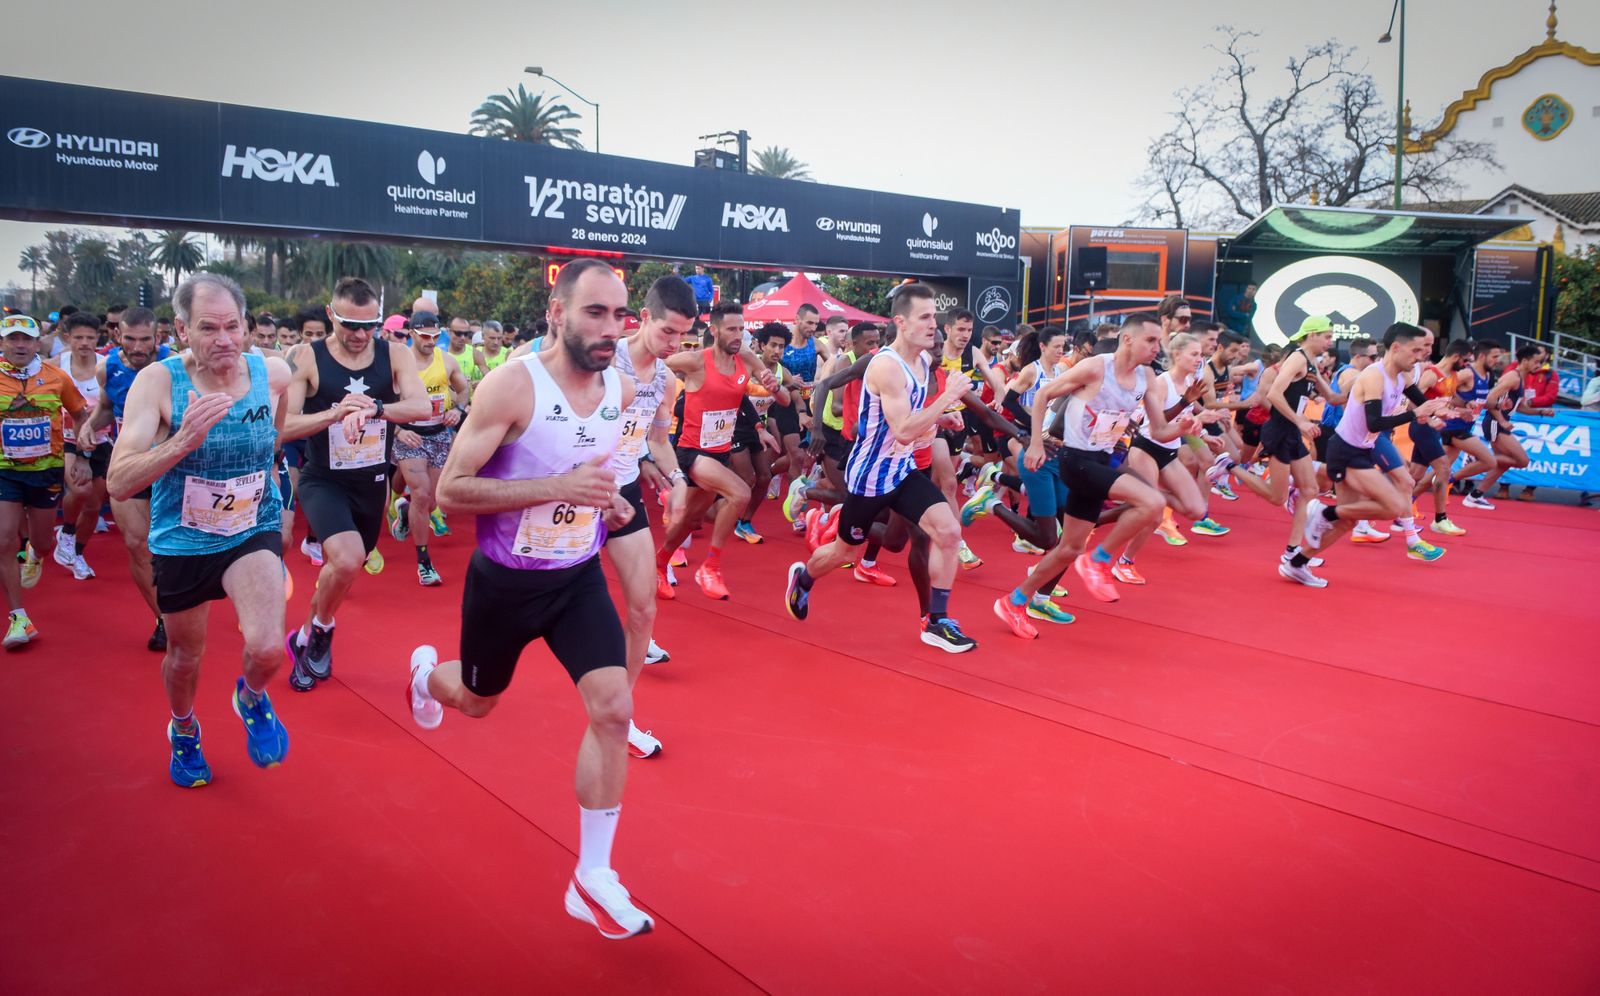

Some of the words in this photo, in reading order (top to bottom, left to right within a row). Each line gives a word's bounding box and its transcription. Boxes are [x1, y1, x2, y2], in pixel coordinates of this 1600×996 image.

[56, 133, 159, 158] HYUNDAI
[56, 152, 123, 169] Hyundauto
[125, 159, 159, 172] Motor
[221, 144, 337, 187] HOKA
[387, 183, 476, 206] quirónsalud
[558, 179, 664, 210] maratón
[394, 204, 438, 218] Healthcare
[439, 208, 469, 220] Partner
[721, 202, 788, 232] HOKA
[836, 220, 881, 235] HYUNDAI
[571, 227, 586, 241] 28
[588, 231, 619, 244] enero
[621, 232, 648, 246] 2024
[909, 251, 934, 260] Healthcare
[934, 253, 949, 261] Partner
[1332, 323, 1360, 333] RLD
[622, 420, 638, 437] 51
[714, 418, 726, 431] 10
[8, 427, 42, 441] 2490
[353, 429, 366, 445] 7
[1559, 461, 1589, 476] FLY
[235, 475, 257, 487] SEVILLA
[211, 492, 236, 512] 72
[552, 503, 578, 525] 66
